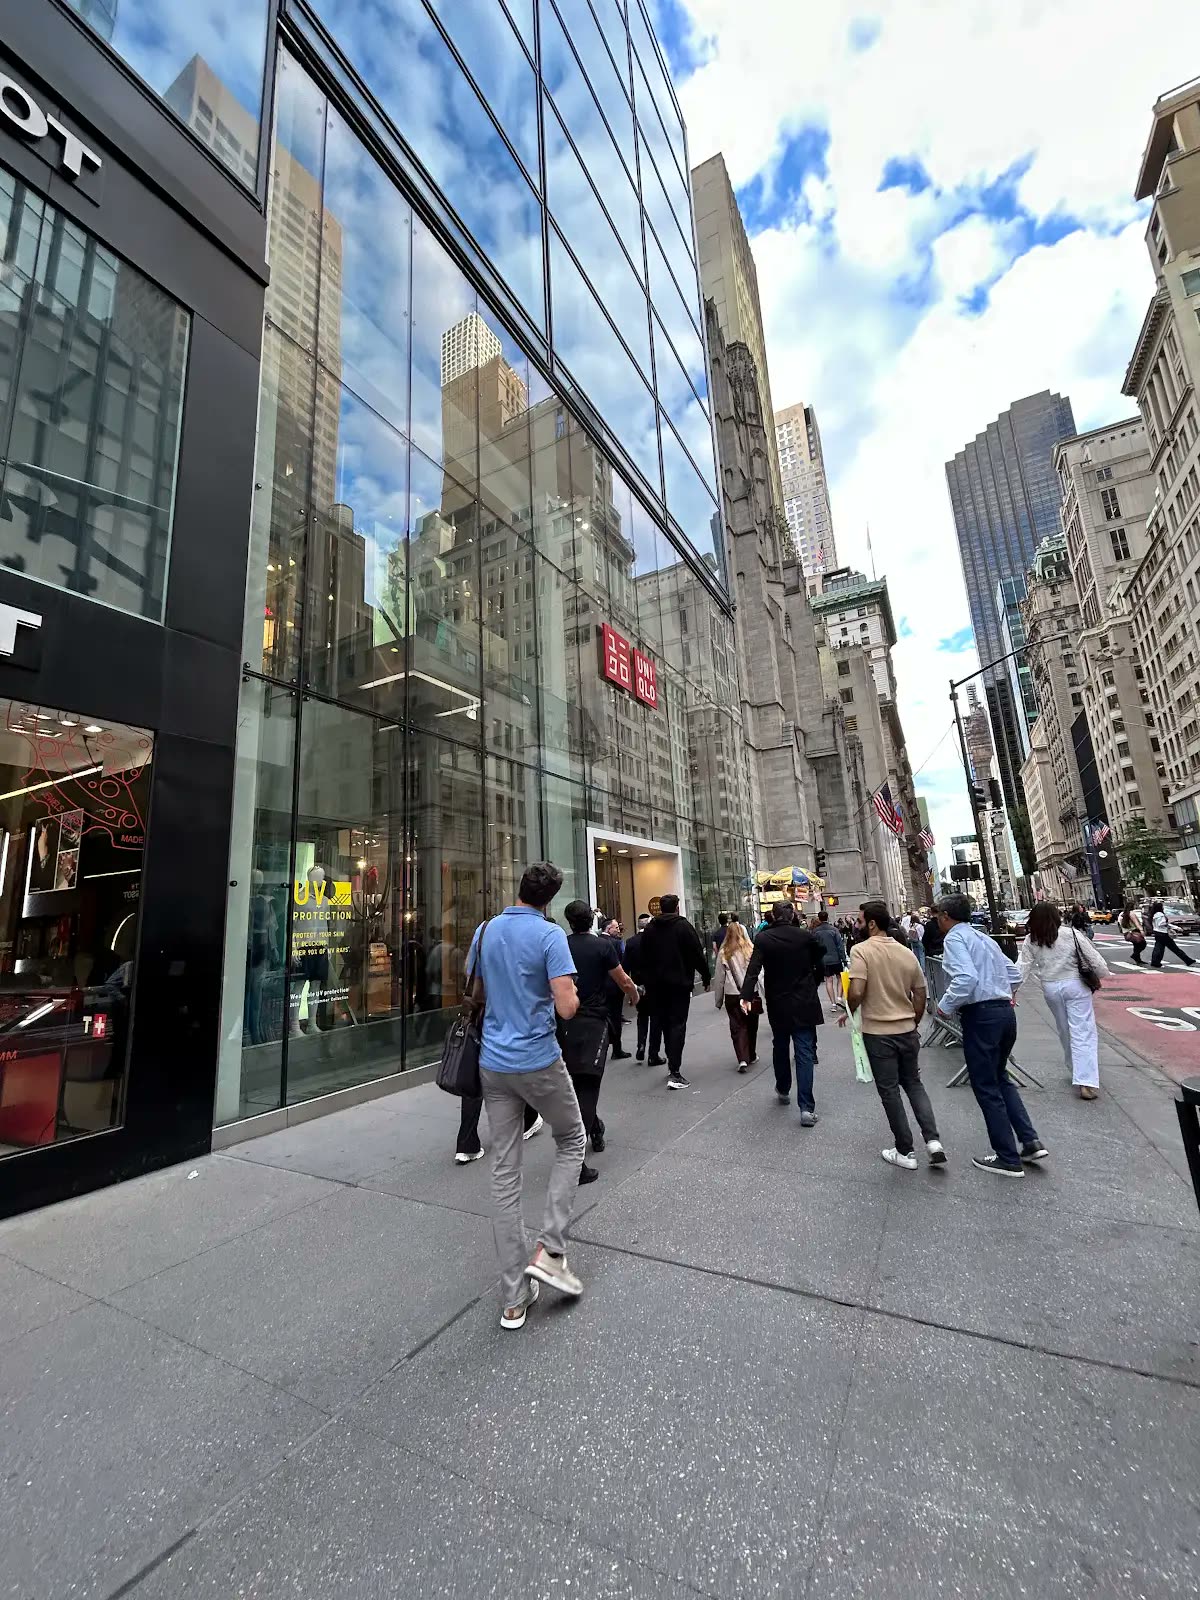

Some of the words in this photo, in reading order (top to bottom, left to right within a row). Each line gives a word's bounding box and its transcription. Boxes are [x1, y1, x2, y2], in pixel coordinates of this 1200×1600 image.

[636, 655, 653, 682] UNI
[638, 676, 656, 701] QLO
[120, 834, 144, 844] MADE
[294, 880, 327, 905] UV
[293, 911, 352, 921] PROTECTION
